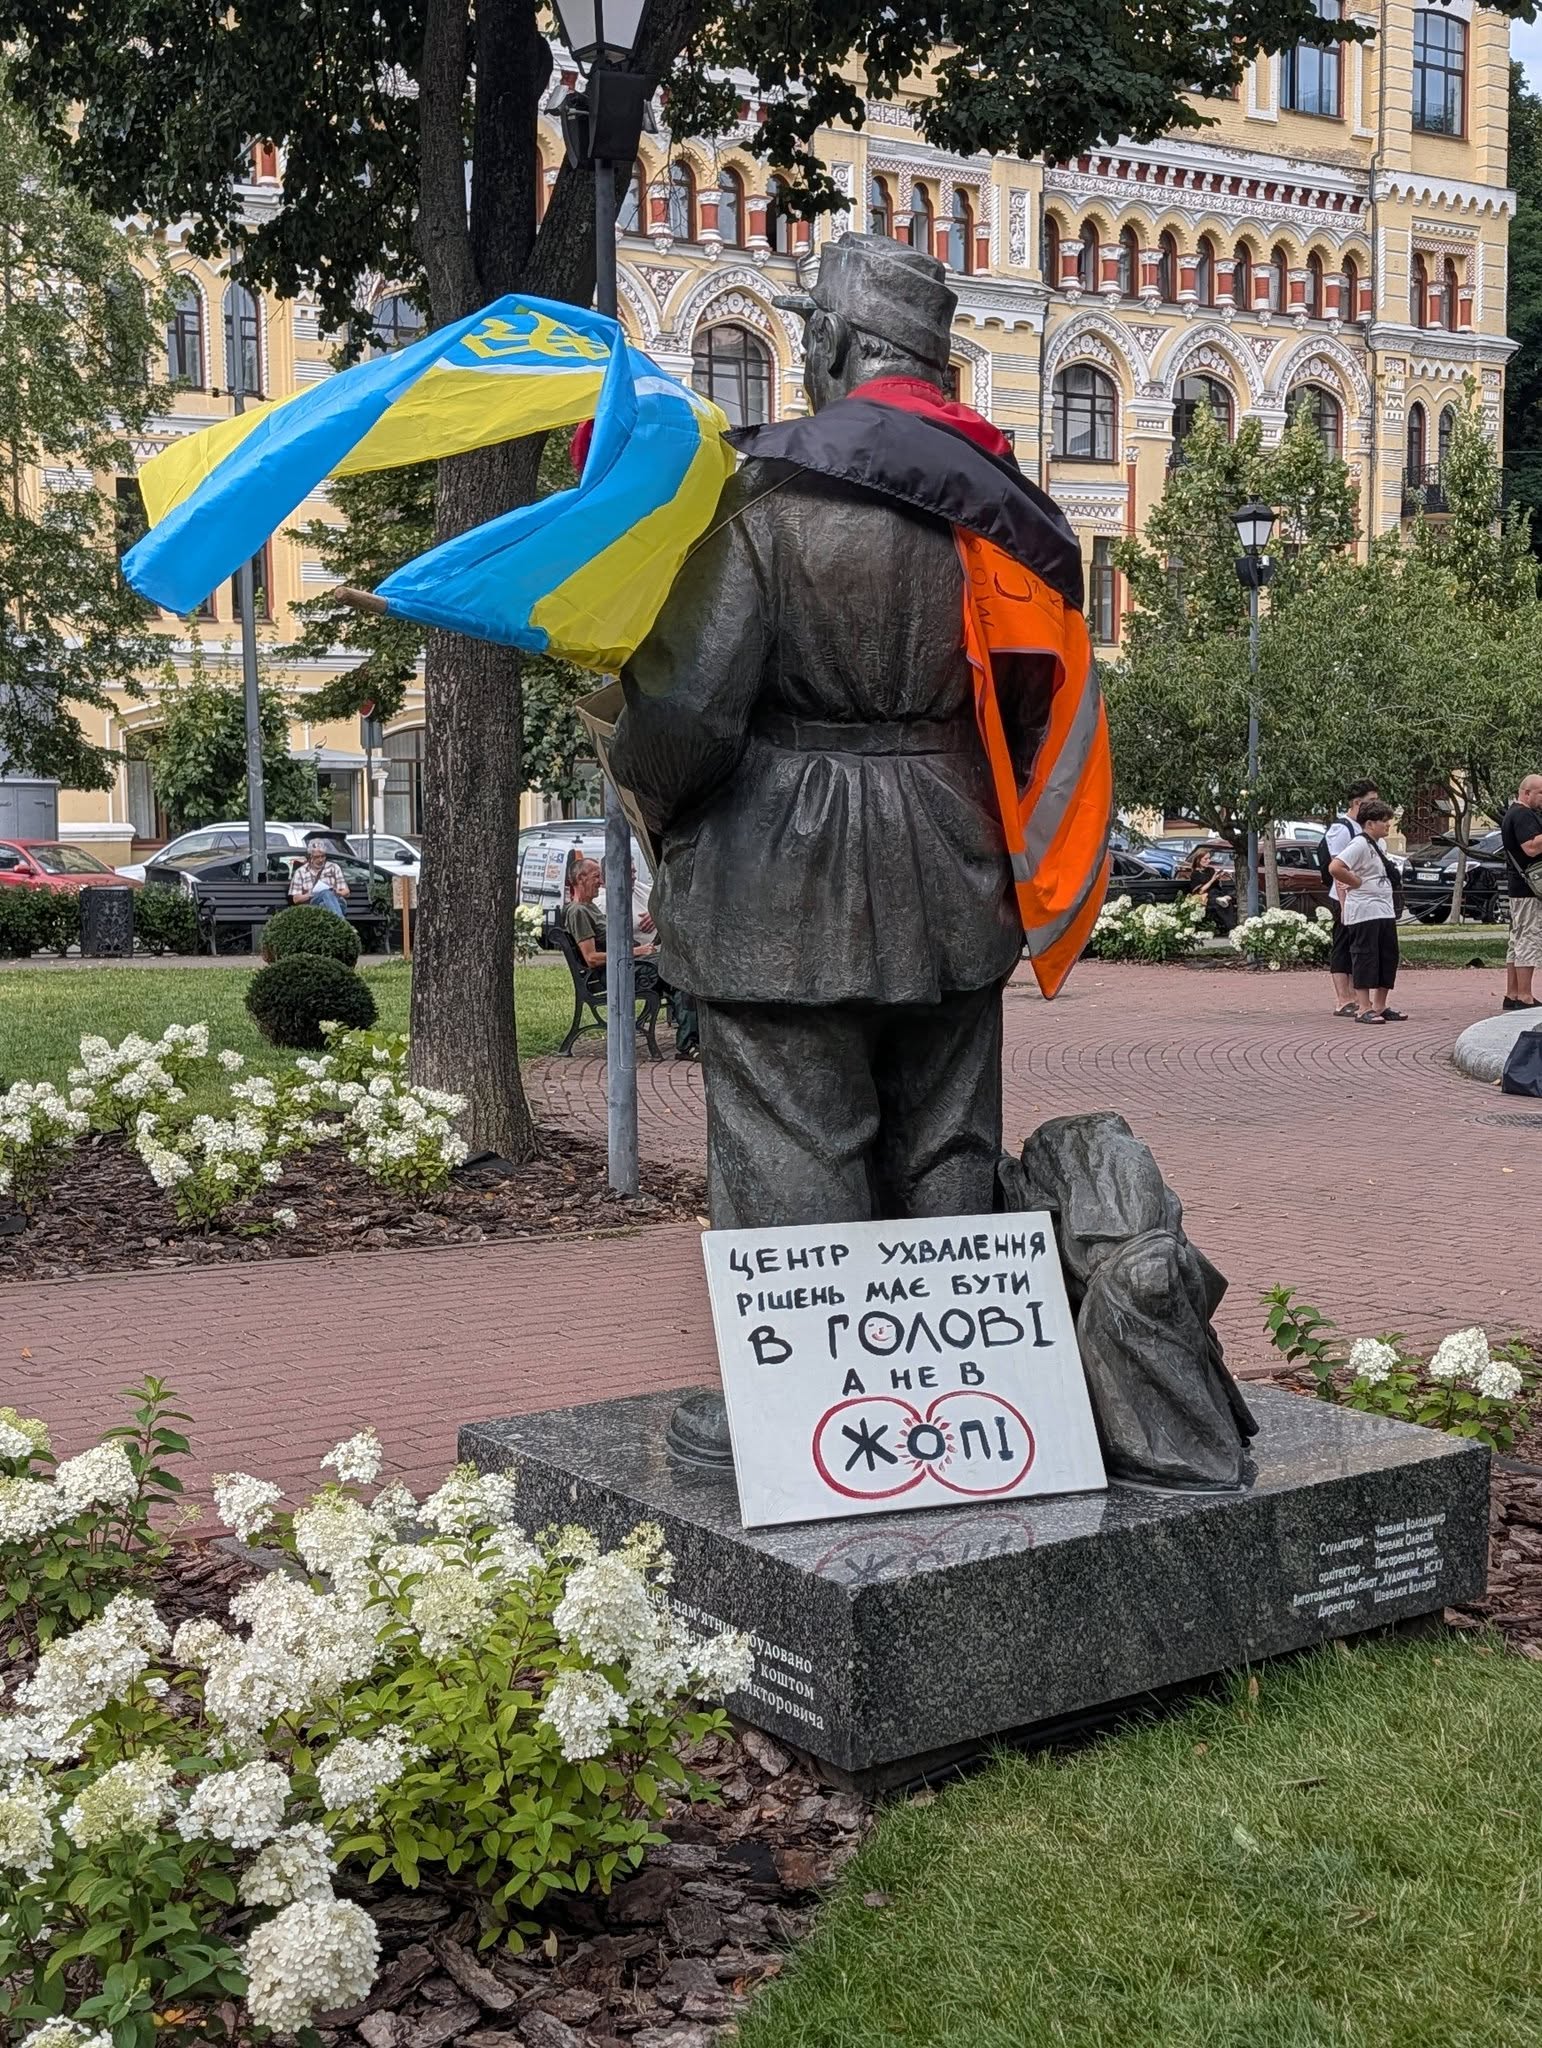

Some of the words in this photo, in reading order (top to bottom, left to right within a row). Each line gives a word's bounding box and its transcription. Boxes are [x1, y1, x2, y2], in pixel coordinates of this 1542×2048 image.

[730, 1245, 849, 1280] ЦЕНТР
[878, 1232, 1045, 1264] УХВАЛЕННЯ
[737, 1286, 845, 1317] РІШЕНЬ
[866, 1278, 930, 1304] МАЄ
[952, 1271, 1029, 1295] БУТИ
[748, 1326, 792, 1365] В
[828, 1301, 1055, 1359] ГОЛОВІ
[843, 1369, 865, 1396] А
[891, 1367, 938, 1390] НЕ
[960, 1362, 984, 1385] В
[841, 1417, 1014, 1472] ЖОПІ
[761, 1662, 814, 1700] коштом
